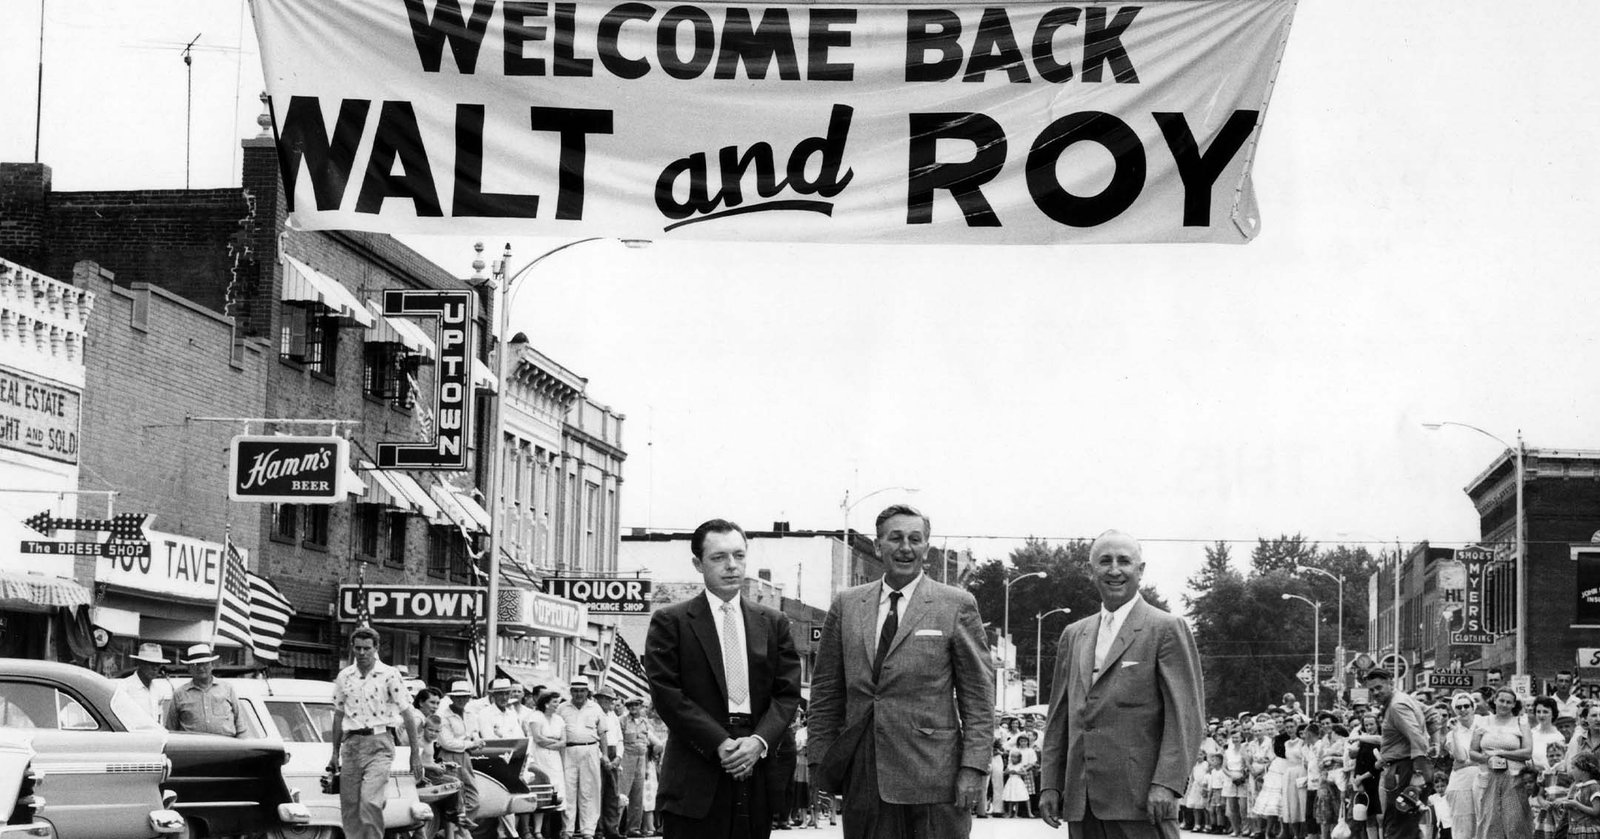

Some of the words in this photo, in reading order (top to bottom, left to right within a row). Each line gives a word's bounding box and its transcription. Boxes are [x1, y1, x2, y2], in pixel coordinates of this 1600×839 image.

[403, 0, 857, 81] WELCOME
[905, 6, 1143, 84] BACK
[268, 95, 613, 220] WALT
[652, 104, 853, 226] and
[906, 110, 1259, 227] ROY
[438, 303, 465, 456] UPTOWN
[25, 384, 65, 417] ESTATE
[26, 427, 43, 441] AND
[48, 428, 76, 454] SOLD
[241, 447, 332, 489] Hamm's
[291, 480, 330, 491] BEER
[28, 542, 50, 553] The
[58, 544, 101, 555] DRESS
[109, 545, 144, 556] SHOP
[1458, 551, 1492, 560] SHOES
[549, 581, 642, 600] LIQUOR
[1469, 563, 1480, 631] MYERS
[344, 591, 483, 617] UPTOWN
[623, 603, 644, 611] SHOP
[1431, 676, 1470, 685] DRUGS
